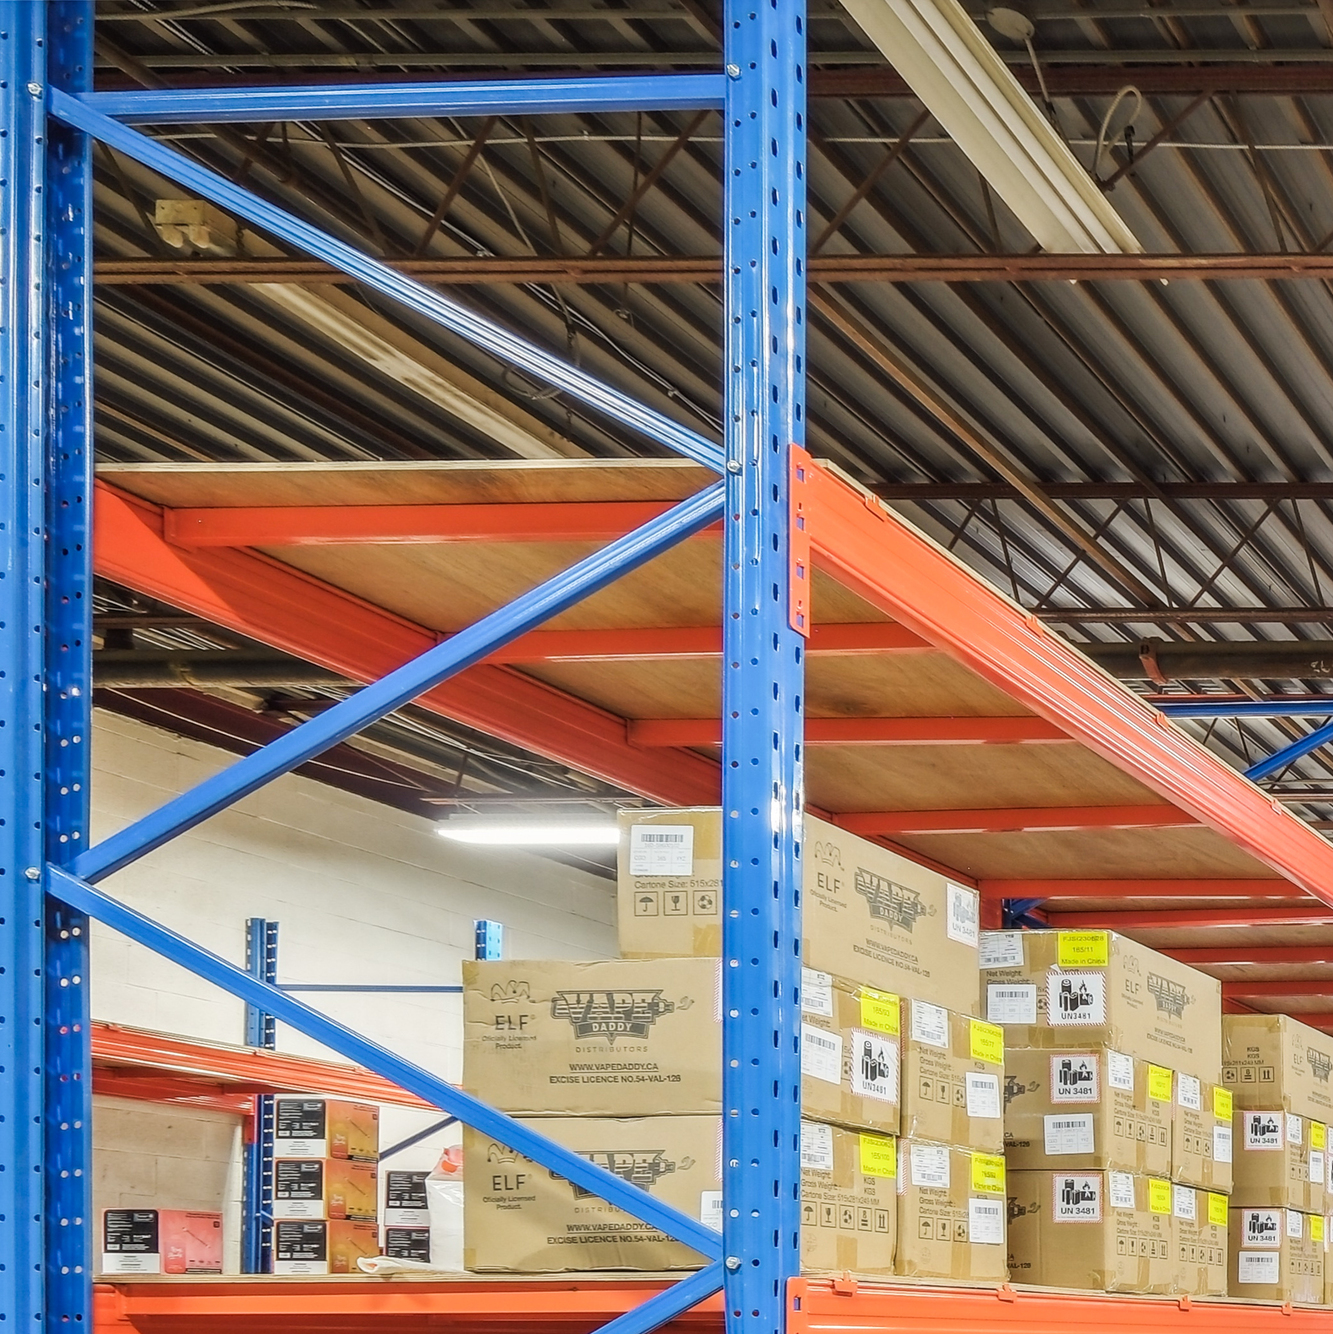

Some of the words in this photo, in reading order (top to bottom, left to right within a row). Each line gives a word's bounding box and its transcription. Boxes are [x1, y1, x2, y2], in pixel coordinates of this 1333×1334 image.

[634, 880, 666, 889] Cartone
[668, 880, 688, 889] Size:
[1125, 980, 1140, 993] ELF
[565, 992, 655, 1022] VAPE
[495, 1014, 529, 1031] ELF
[592, 1022, 632, 1031] DADDY
[569, 1063, 659, 1071] WWW.VAPEDADDY.CA
[550, 1076, 580, 1084] EXCISE
[582, 1076, 619, 1084] LICENCE
[1073, 1087, 1093, 1095] 3481
[492, 1174, 526, 1191] ELF
[863, 1177, 875, 1185] KGS
[863, 1187, 875, 1196] KGS
[1075, 1207, 1095, 1215] 3481
[547, 1236, 577, 1244] EXCISE
[579, 1236, 618, 1244] LICENCE
